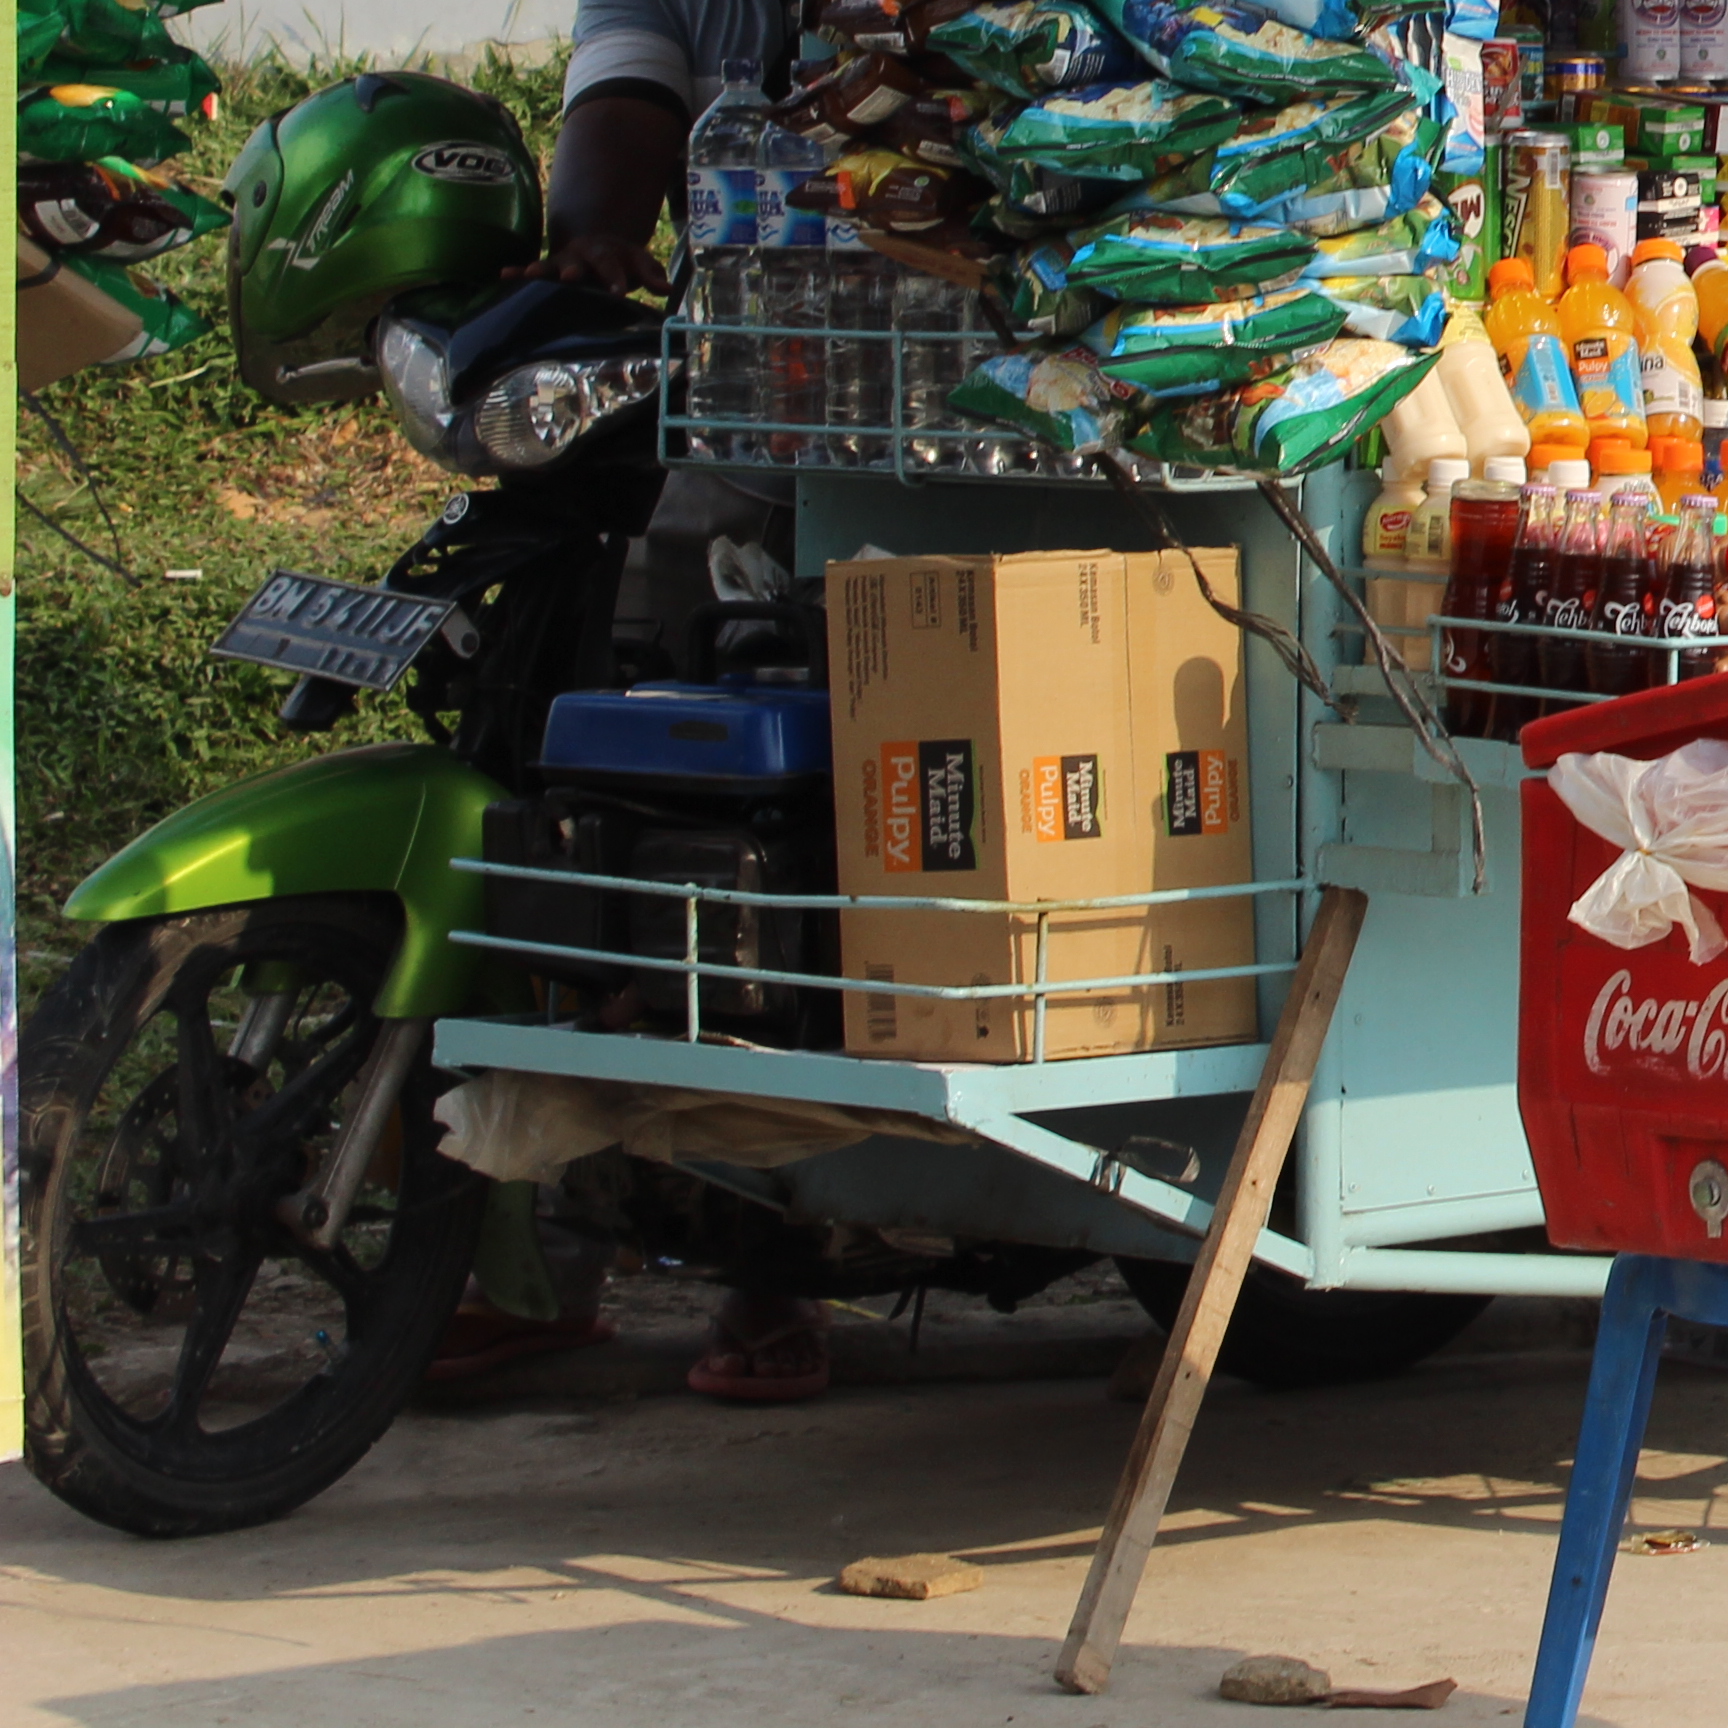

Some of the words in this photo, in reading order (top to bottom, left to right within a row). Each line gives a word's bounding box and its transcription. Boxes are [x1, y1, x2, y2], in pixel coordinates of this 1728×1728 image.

[862, 758, 880, 858] ORANGE
[888, 755, 916, 865] Pulpy
[928, 767, 947, 848] Maid
[946, 752, 963, 860] Minute
[1036, 764, 1059, 837] Pulpy
[1066, 770, 1081, 828] Maid
[1078, 760, 1095, 834] Minute
[1172, 757, 1186, 830] Minute
[1184, 766, 1197, 819] Maid
[1203, 753, 1224, 827] Pulpy
